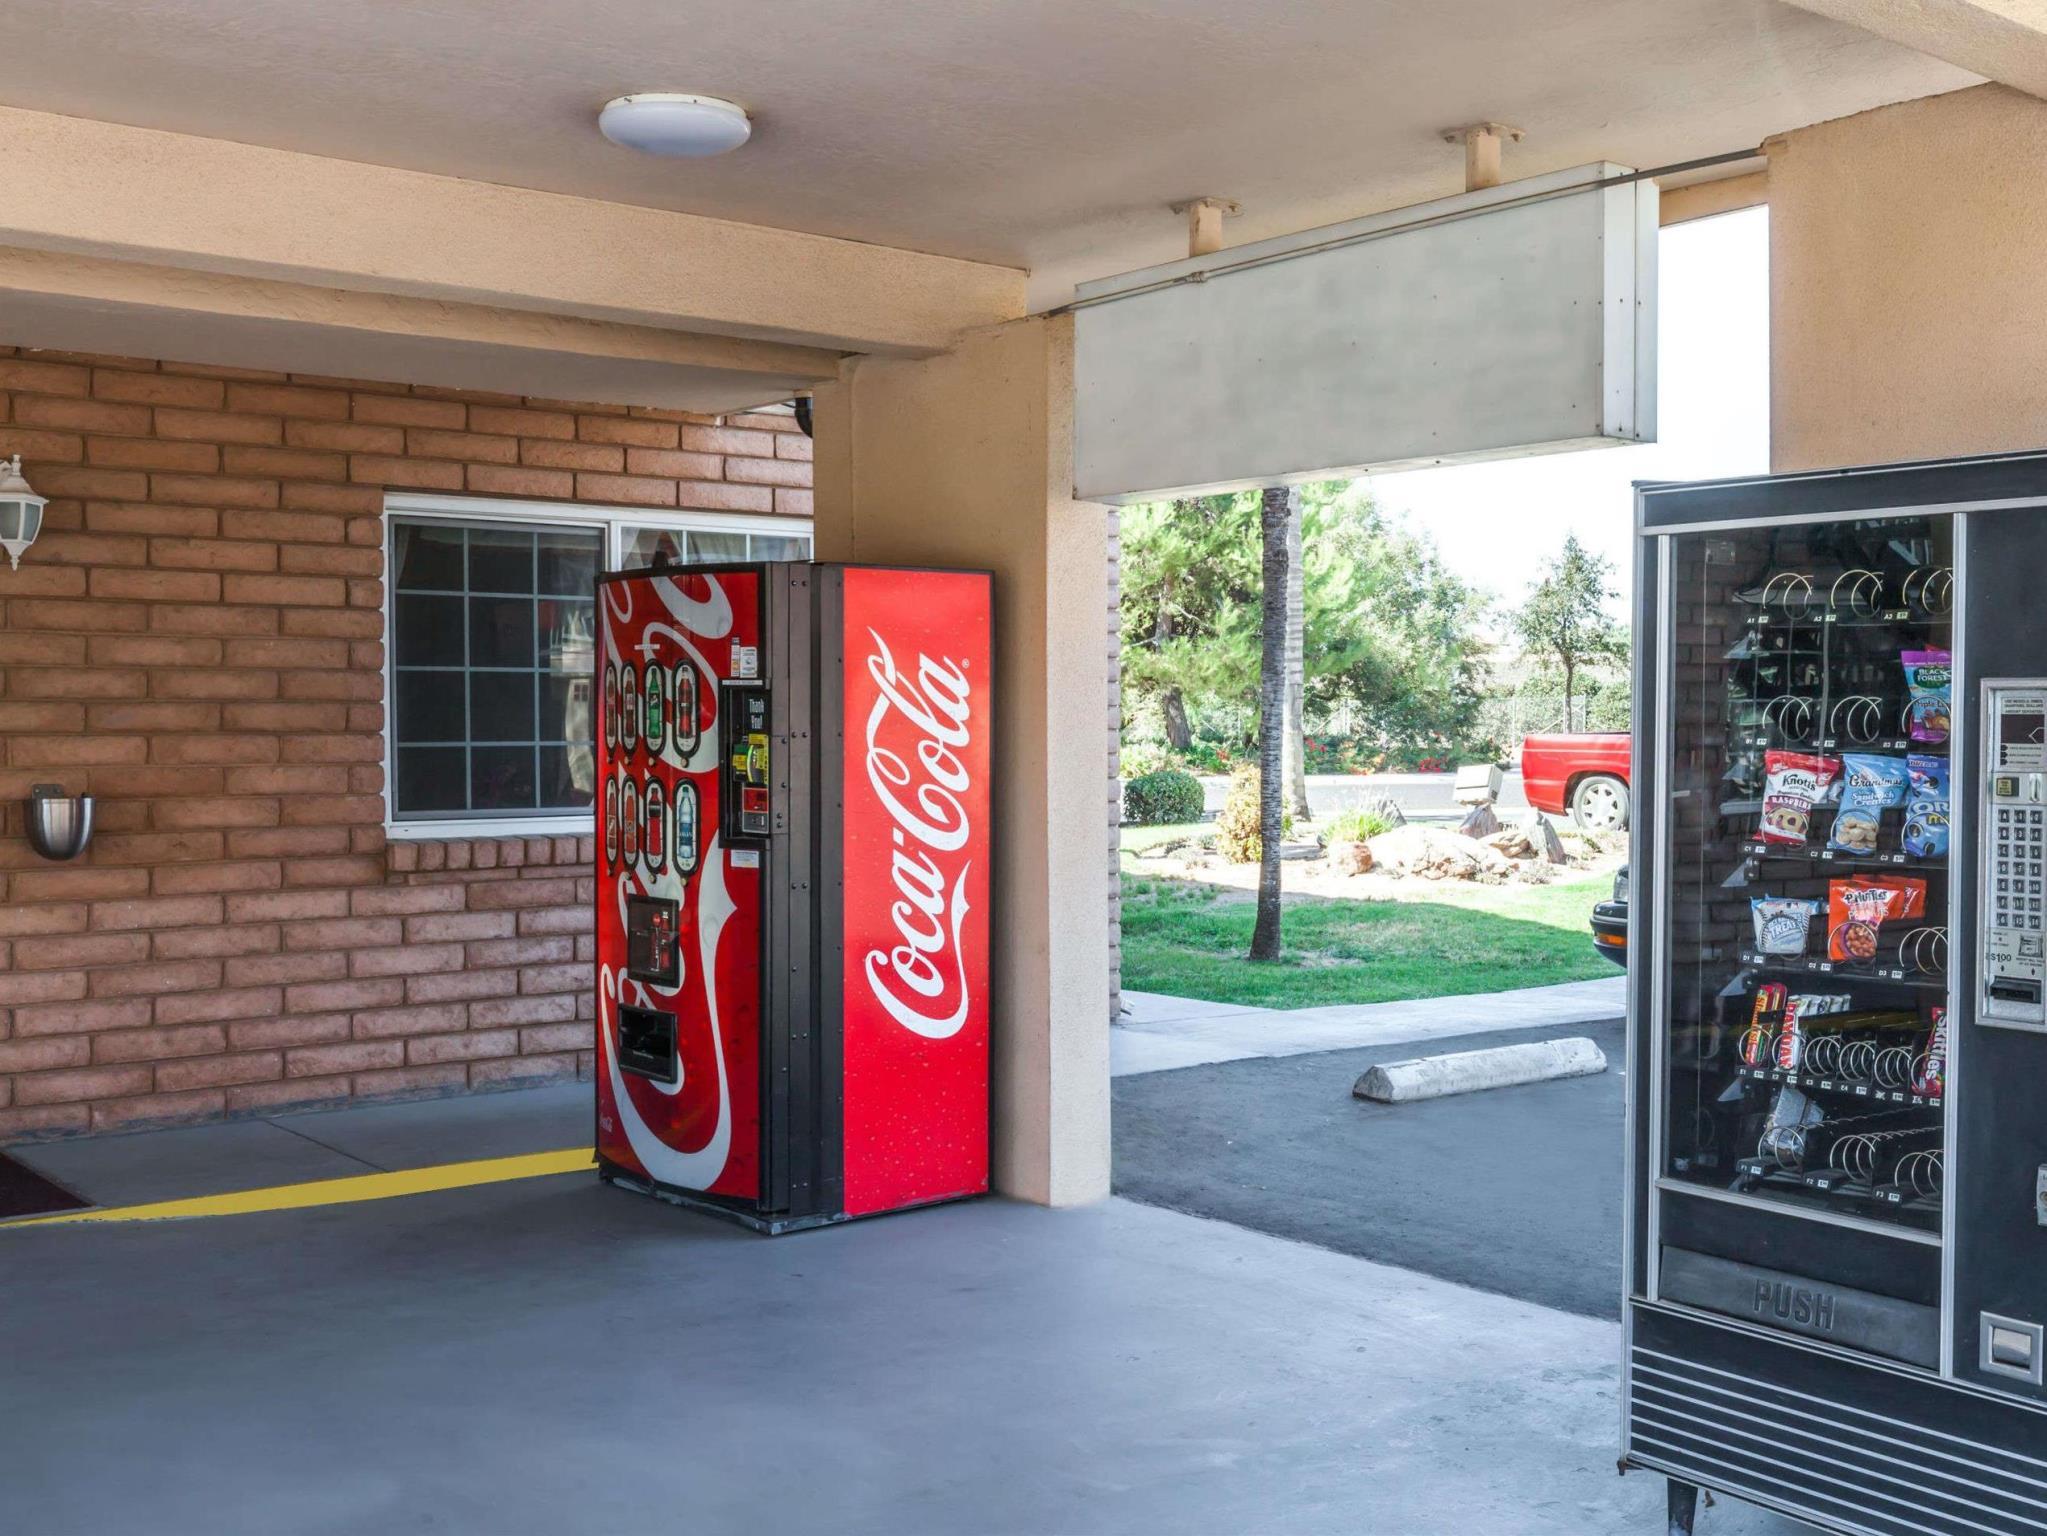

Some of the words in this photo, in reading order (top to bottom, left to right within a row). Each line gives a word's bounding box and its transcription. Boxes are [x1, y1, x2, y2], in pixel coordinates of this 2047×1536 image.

[1917, 674, 1947, 682] FOREST
[865, 626, 972, 1040] Coca-Cola
[1752, 1278, 1836, 1331] PUSH
